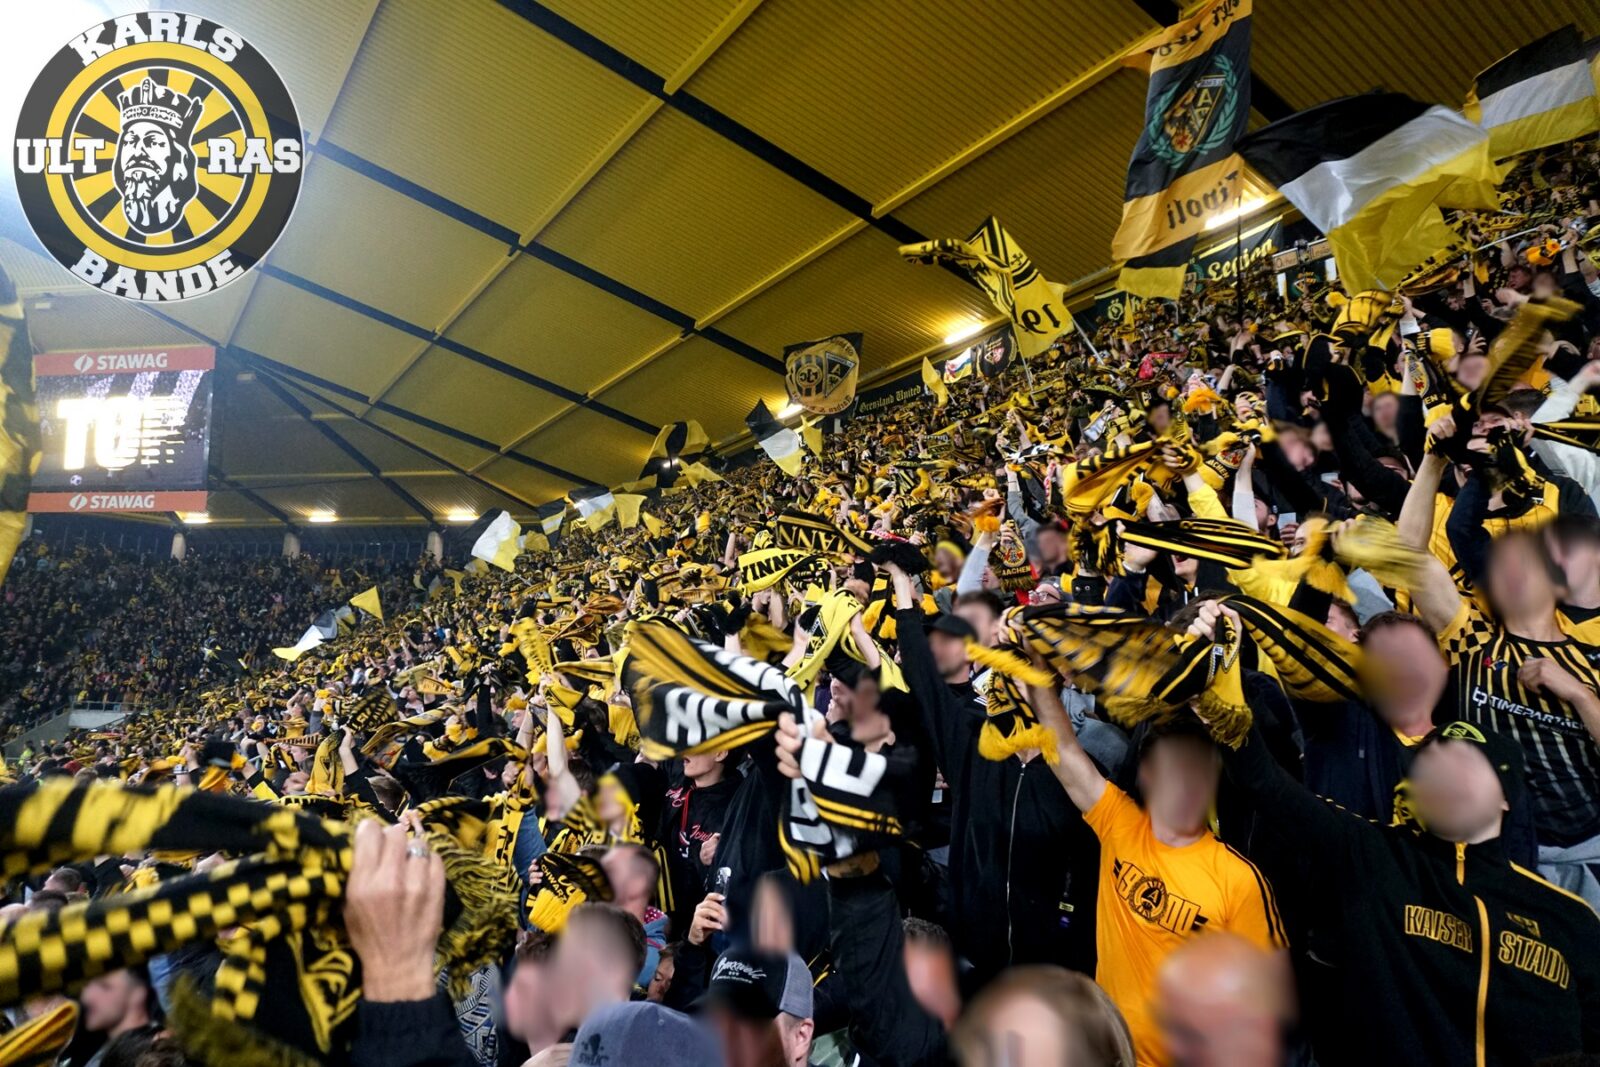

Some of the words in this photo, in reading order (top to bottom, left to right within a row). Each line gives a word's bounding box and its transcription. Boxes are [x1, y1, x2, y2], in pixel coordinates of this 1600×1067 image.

[96, 352, 168, 371] STAWAG
[90, 494, 155, 509] STAWAG
[1404, 904, 1474, 954] KAISER
